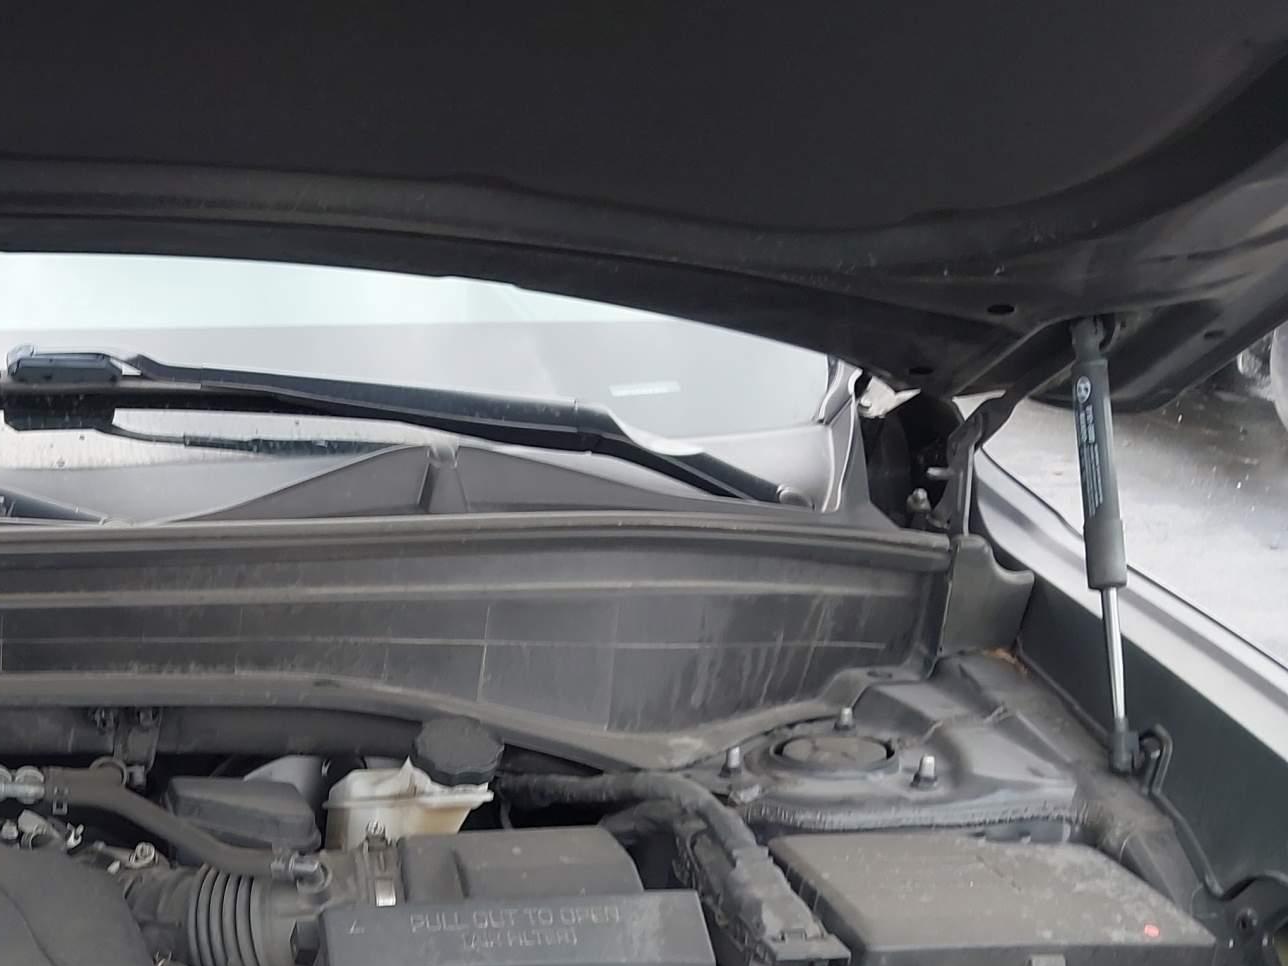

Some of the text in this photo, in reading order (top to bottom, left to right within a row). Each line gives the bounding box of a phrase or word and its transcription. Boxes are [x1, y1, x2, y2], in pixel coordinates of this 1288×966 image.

[410, 904, 621, 933] PULL OUT TO OPEN
